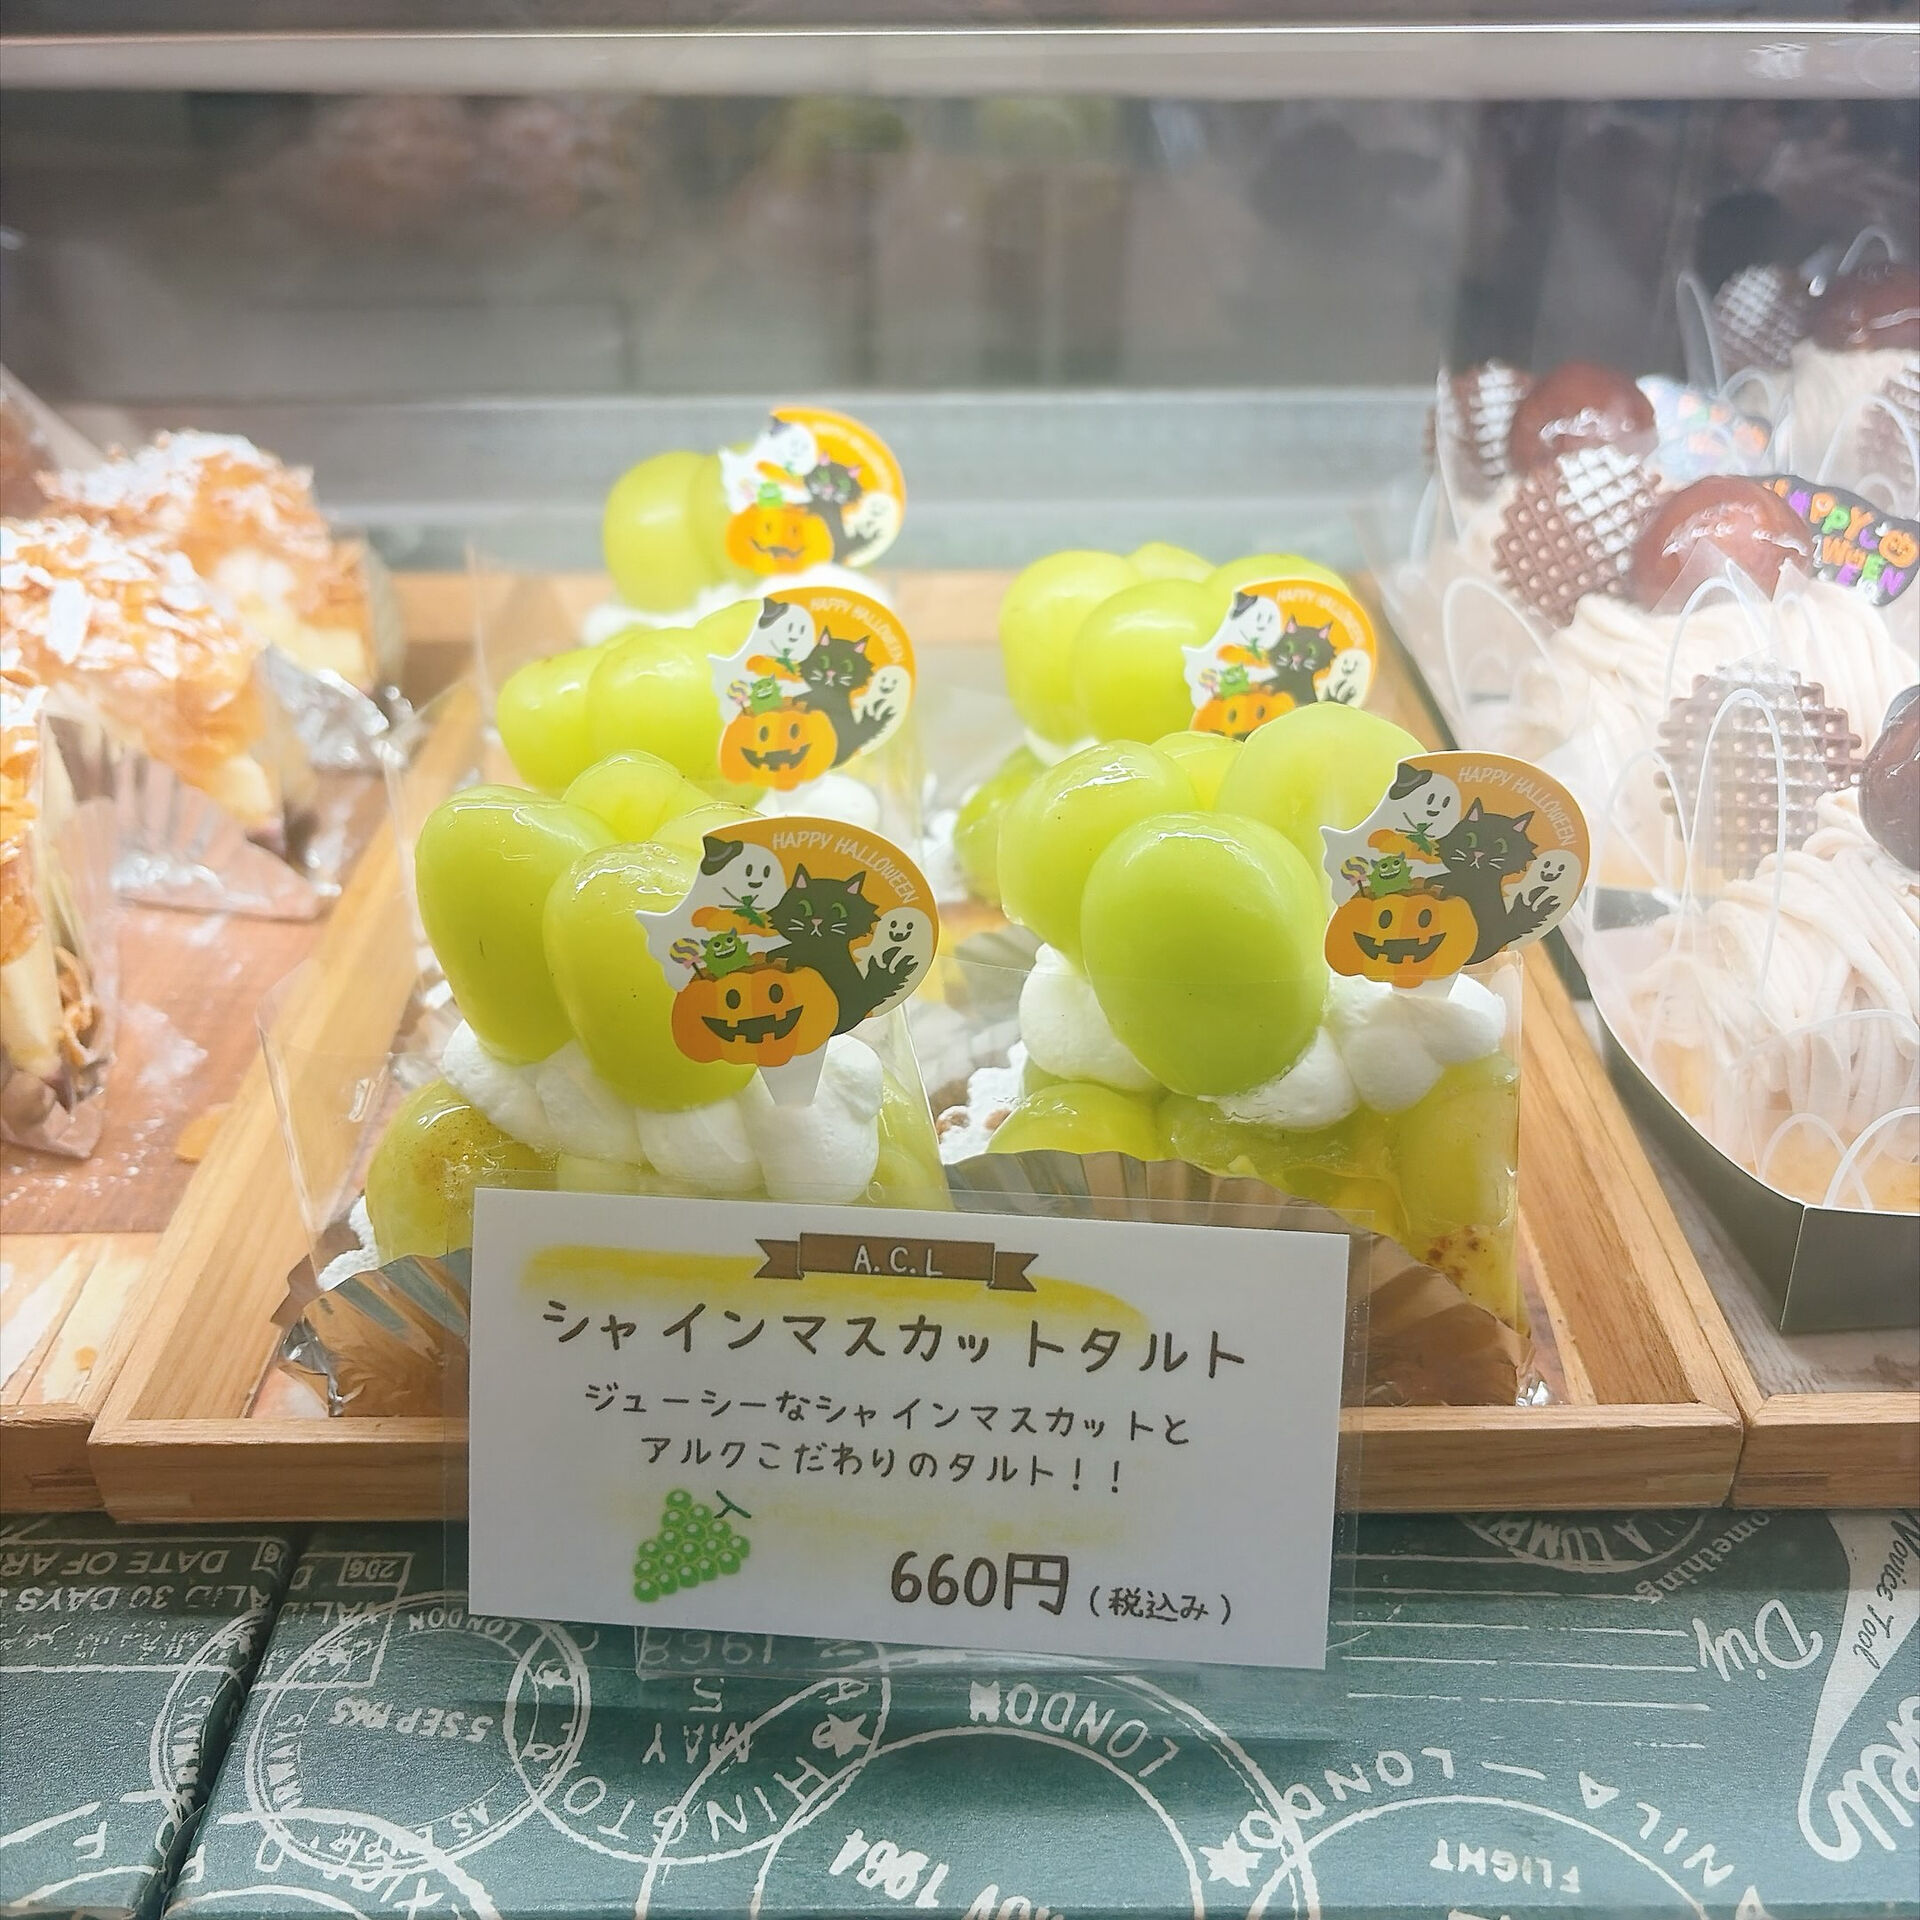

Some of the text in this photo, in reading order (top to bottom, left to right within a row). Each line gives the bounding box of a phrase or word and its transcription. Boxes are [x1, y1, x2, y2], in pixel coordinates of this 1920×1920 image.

[1458, 766, 1577, 846] HAPPY HALLOWEEN
[772, 831, 920, 904] HAPPY HALLOWEEN
[853, 1244, 943, 1277] A.C.L
[542, 1299, 1245, 1379] シャインマスカットタルト
[584, 1381, 1190, 1446] ジューシーなシャインマスカットと
[60, 1550, 119, 1575] OF
[125, 1550, 230, 1575] DATE
[890, 1550, 1070, 1616] 660円
[1634, 1511, 1771, 1604] omething
[15, 1586, 122, 1612] DAYS
[1692, 1599, 1824, 1682] Diy
[1853, 1604, 1895, 1669] Tool
[968, 1680, 1179, 1778] LONDON
[1429, 1837, 1581, 1894] FLIGHT
